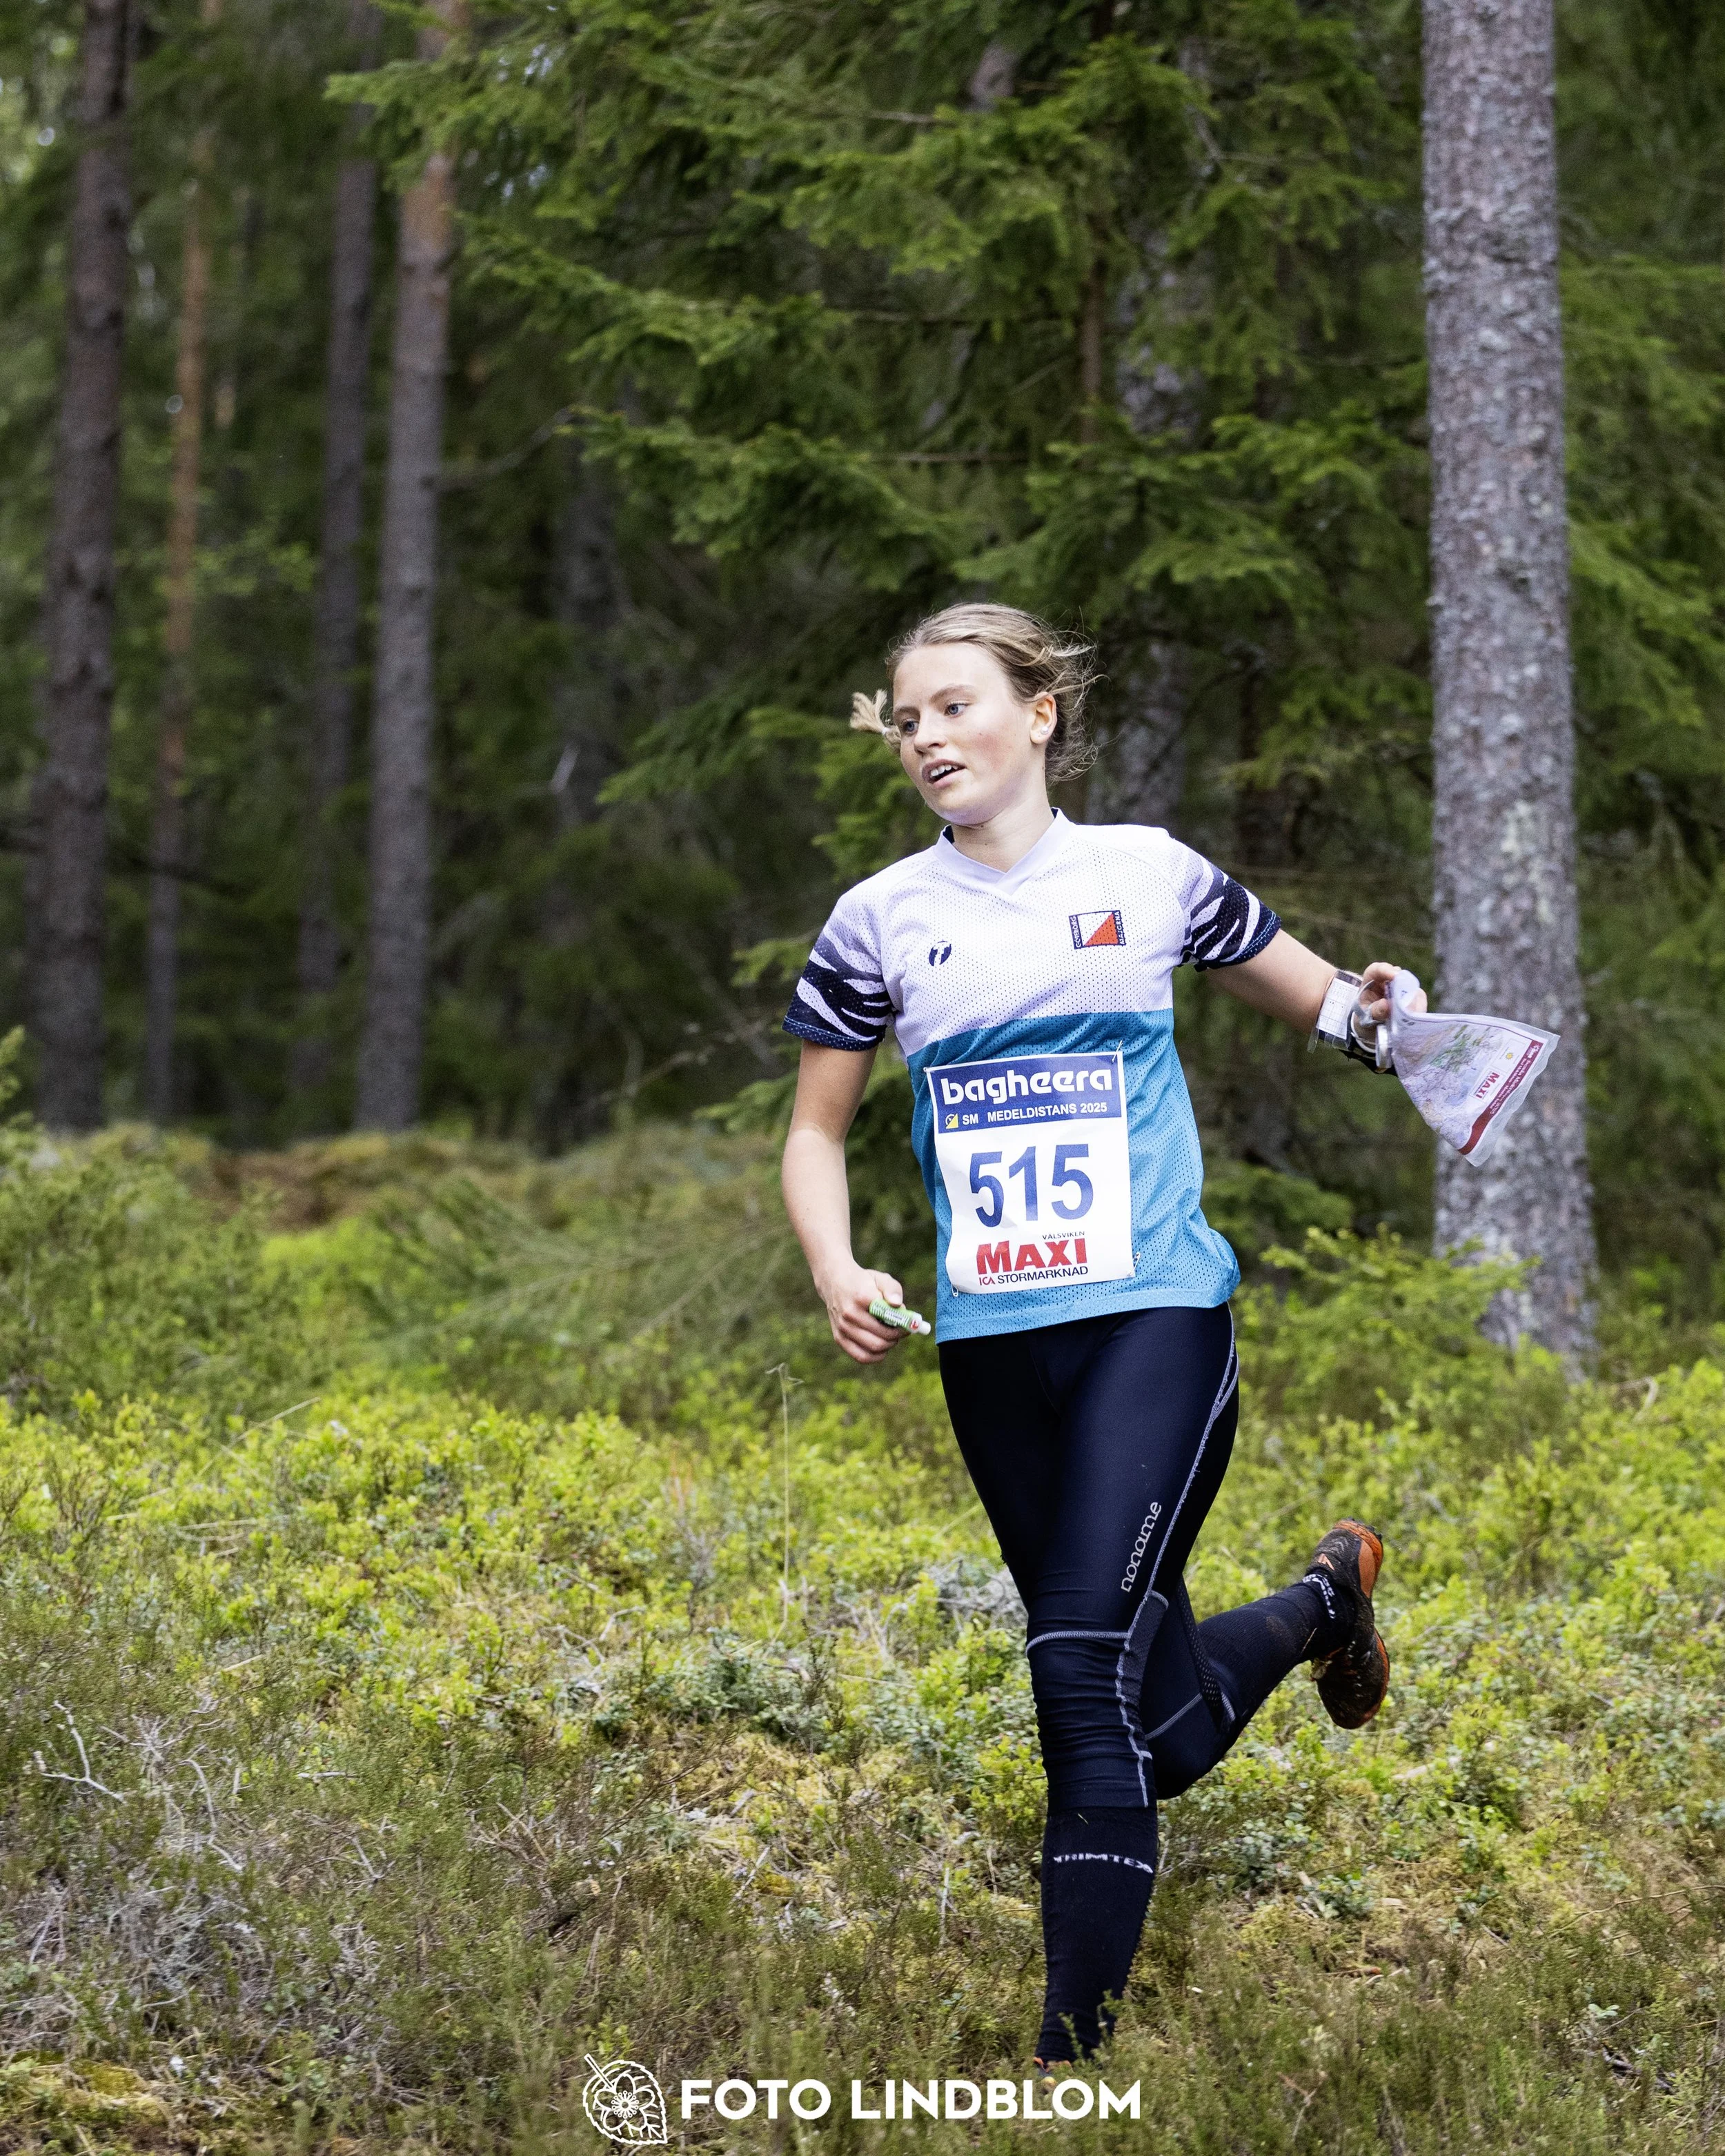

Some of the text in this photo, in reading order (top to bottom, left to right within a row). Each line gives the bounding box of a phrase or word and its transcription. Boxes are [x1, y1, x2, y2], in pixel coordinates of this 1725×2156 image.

[940, 1069, 1112, 1105] bagheera
[1475, 1072, 1500, 1099] MAXI
[962, 1102, 1107, 1125] SM MEDELDISTANS 2025
[969, 1143, 1094, 1227] 515
[976, 1238, 1087, 1275] MAXI
[978, 1265, 1089, 1286] ICA STORMARKNAD
[1121, 1501, 1162, 1592] noname
